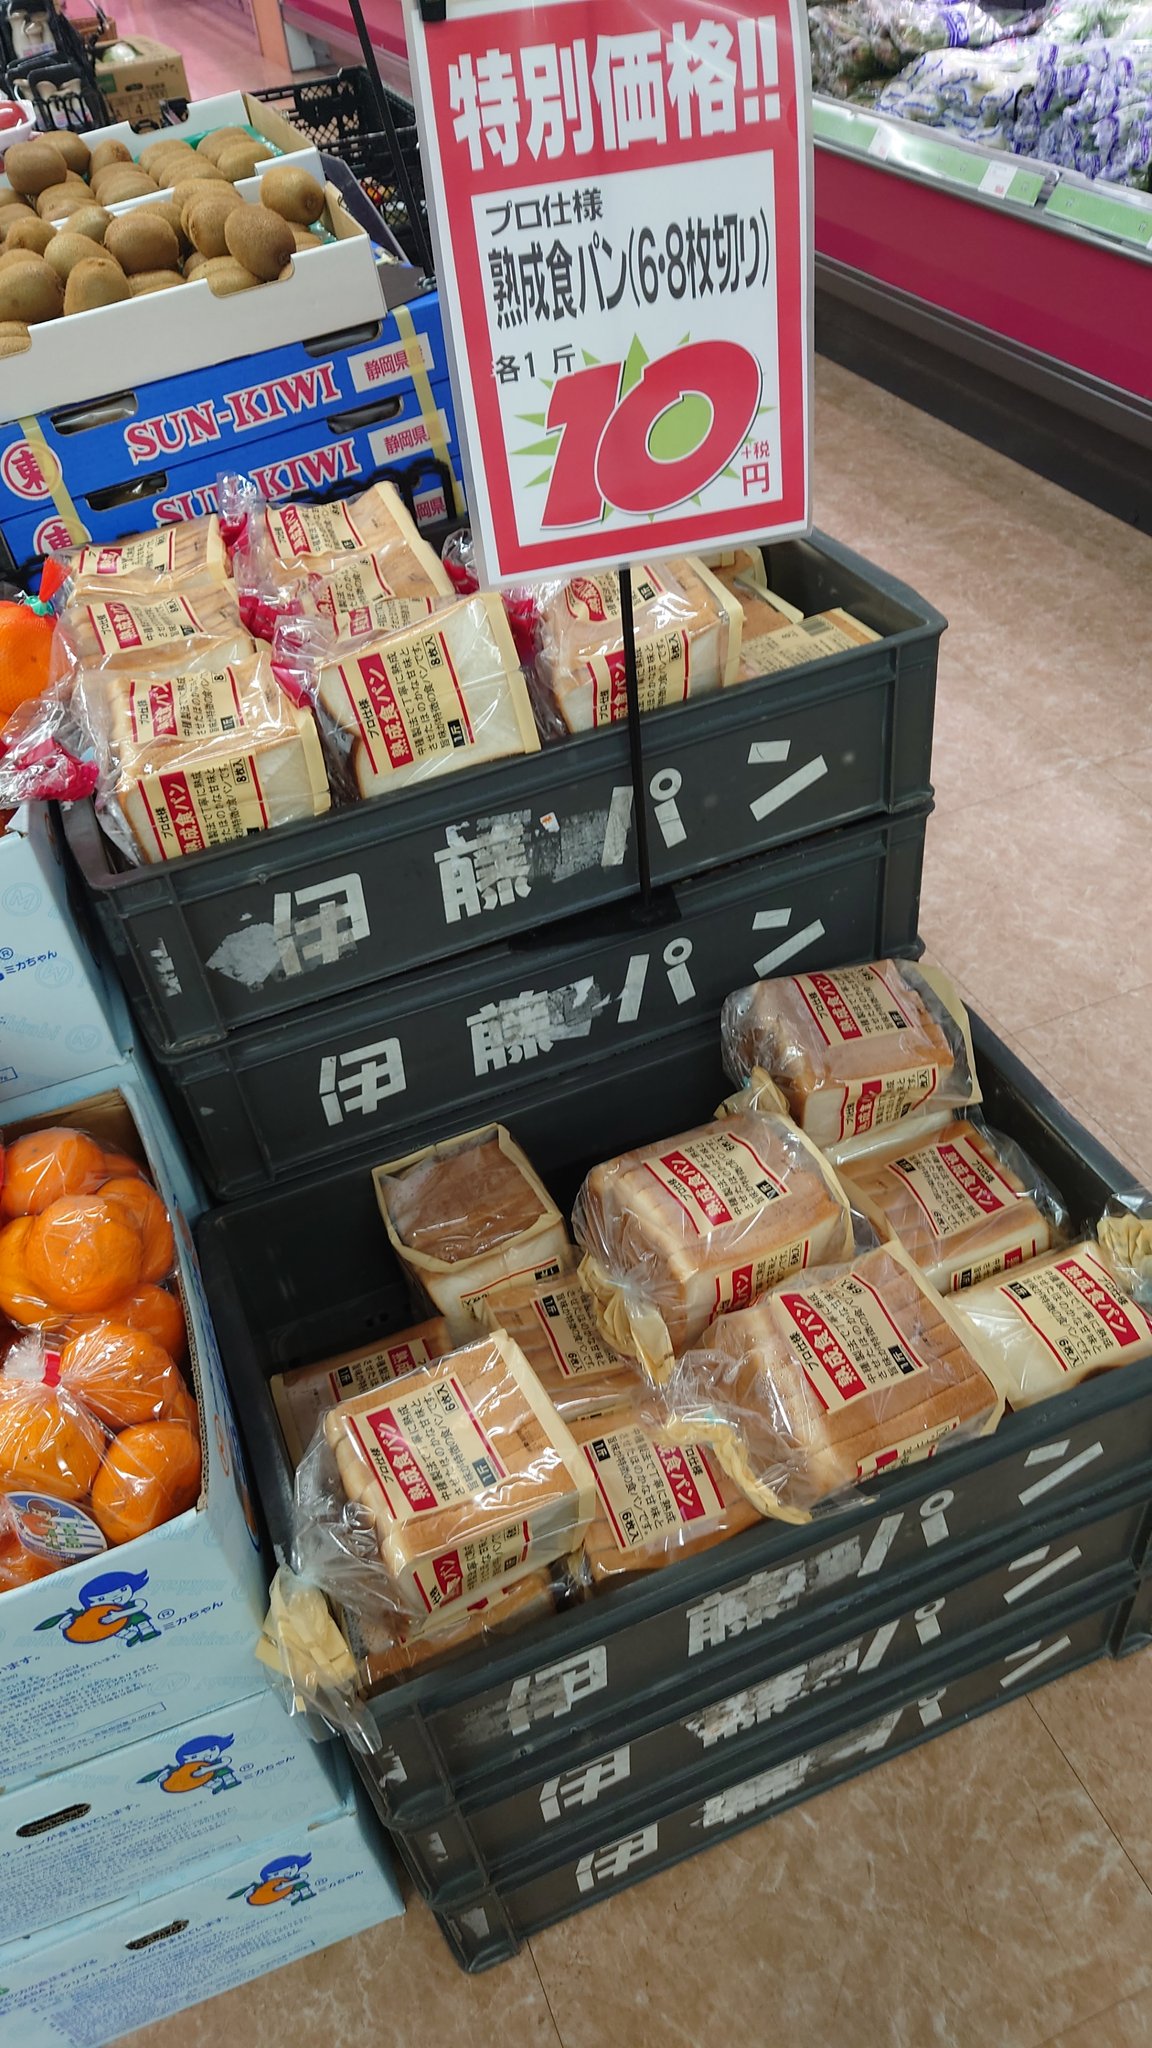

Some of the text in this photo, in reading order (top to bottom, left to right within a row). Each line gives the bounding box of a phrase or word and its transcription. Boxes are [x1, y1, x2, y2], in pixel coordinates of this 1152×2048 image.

[485, 187, 603, 235] プロ仕様
[364, 347, 426, 382] 静岡県
[126, 363, 341, 462] SUN-KIWI
[541, 340, 762, 531] 10
[742, 463, 770, 497] 円
[424, 635, 440, 666] 8枚入
[357, 697, 379, 738] プロ仕様
[364, 664, 409, 758] 熟成食パン
[399, 646, 438, 750] させたほのかな甘味と
[232, 758, 246, 783] 8枚入
[155, 806, 173, 838] プロ仕様
[806, 991, 829, 1018] プロ仕様
[812, 975, 858, 1032] 熟成食パン
[666, 1155, 730, 1217] 熟成食パン
[666, 1176, 692, 1202] プロ仕様
[939, 1150, 997, 1208] 熟成食パン
[970, 1159, 997, 1183] プロ仕様
[1061, 1263, 1133, 1336] 熟成食パン
[1097, 1275, 1128, 1306] プロ仕様
[567, 1352, 583, 1373] 6枚入
[788, 1329, 819, 1372] プロ仕様
[790, 1297, 858, 1390] 熟成食パン
[1055, 1338, 1084, 1367] 6枚入
[434, 1383, 456, 1411] 6枚入
[370, 1445, 393, 1484] プロ仕様
[375, 1417, 430, 1503] 熟成食パン
[620, 1511, 640, 1542] 6枚入
